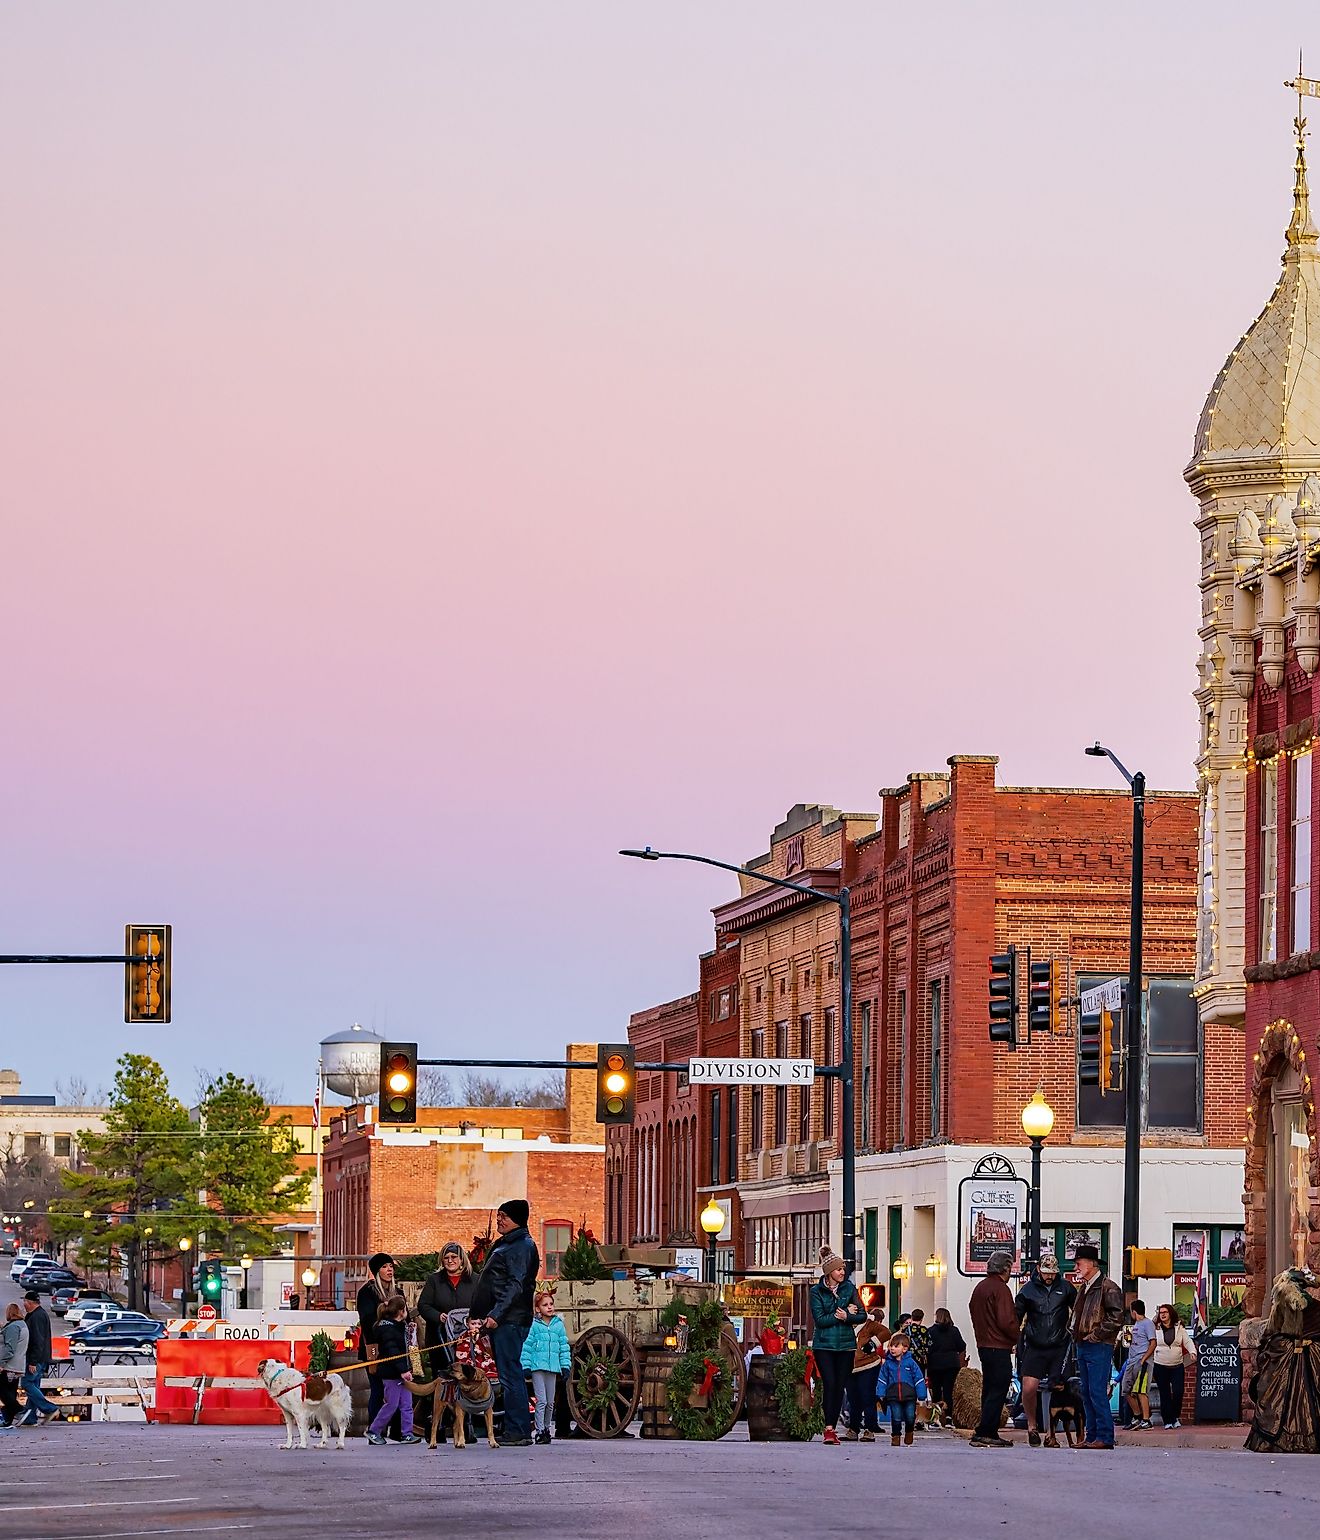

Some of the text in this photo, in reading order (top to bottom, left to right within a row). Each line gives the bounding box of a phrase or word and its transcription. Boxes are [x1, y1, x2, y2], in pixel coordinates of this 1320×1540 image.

[692, 1063, 812, 1078] DIVISION ST
[971, 1191, 1016, 1204] GUTHRIE
[758, 1296, 785, 1305] CRAFT
[199, 1310, 215, 1318] STOP
[224, 1328, 260, 1340] ROAD
[1198, 1343, 1240, 1355] COUNTRY
[1200, 1355, 1238, 1367] CORNER
